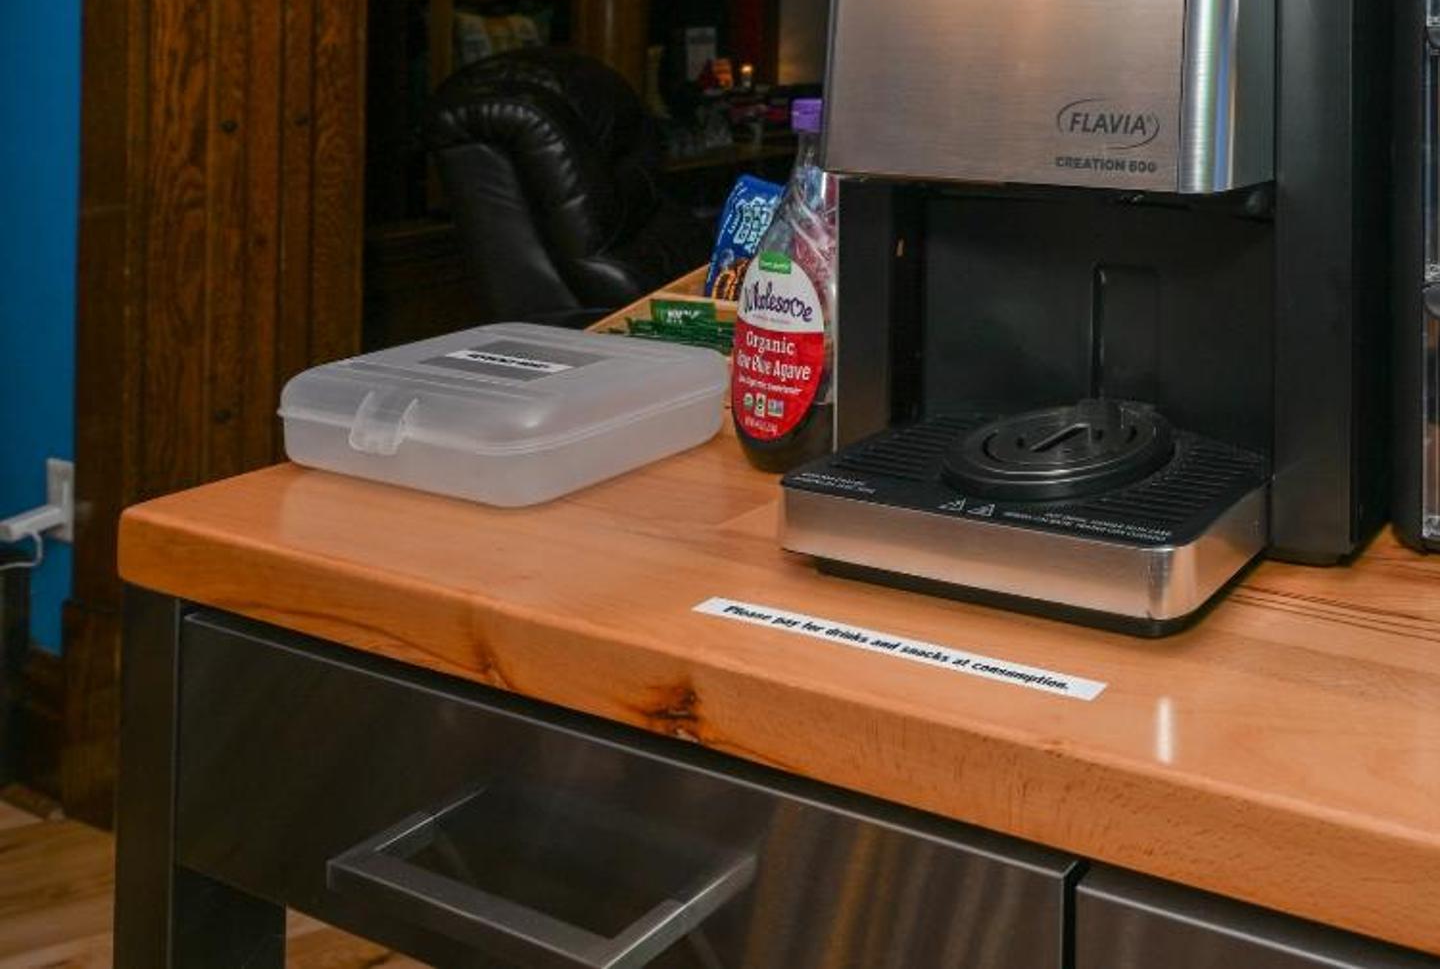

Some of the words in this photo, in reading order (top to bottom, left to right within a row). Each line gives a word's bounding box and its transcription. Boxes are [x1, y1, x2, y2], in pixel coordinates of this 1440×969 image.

[1069, 112, 1146, 136] FLAVIA
[1056, 156, 1125, 172] CREATION
[744, 280, 814, 323] Wholesome
[746, 331, 795, 356] Organic
[773, 360, 811, 382] Agave
[723, 604, 772, 621] Please
[773, 614, 800, 629] pay
[802, 620, 825, 633] for
[824, 627, 869, 645] drinks
[870, 638, 900, 651] and
[900, 644, 949, 664] snacks
[952, 657, 969, 667] at
[971, 661, 1069, 690] consumption.
